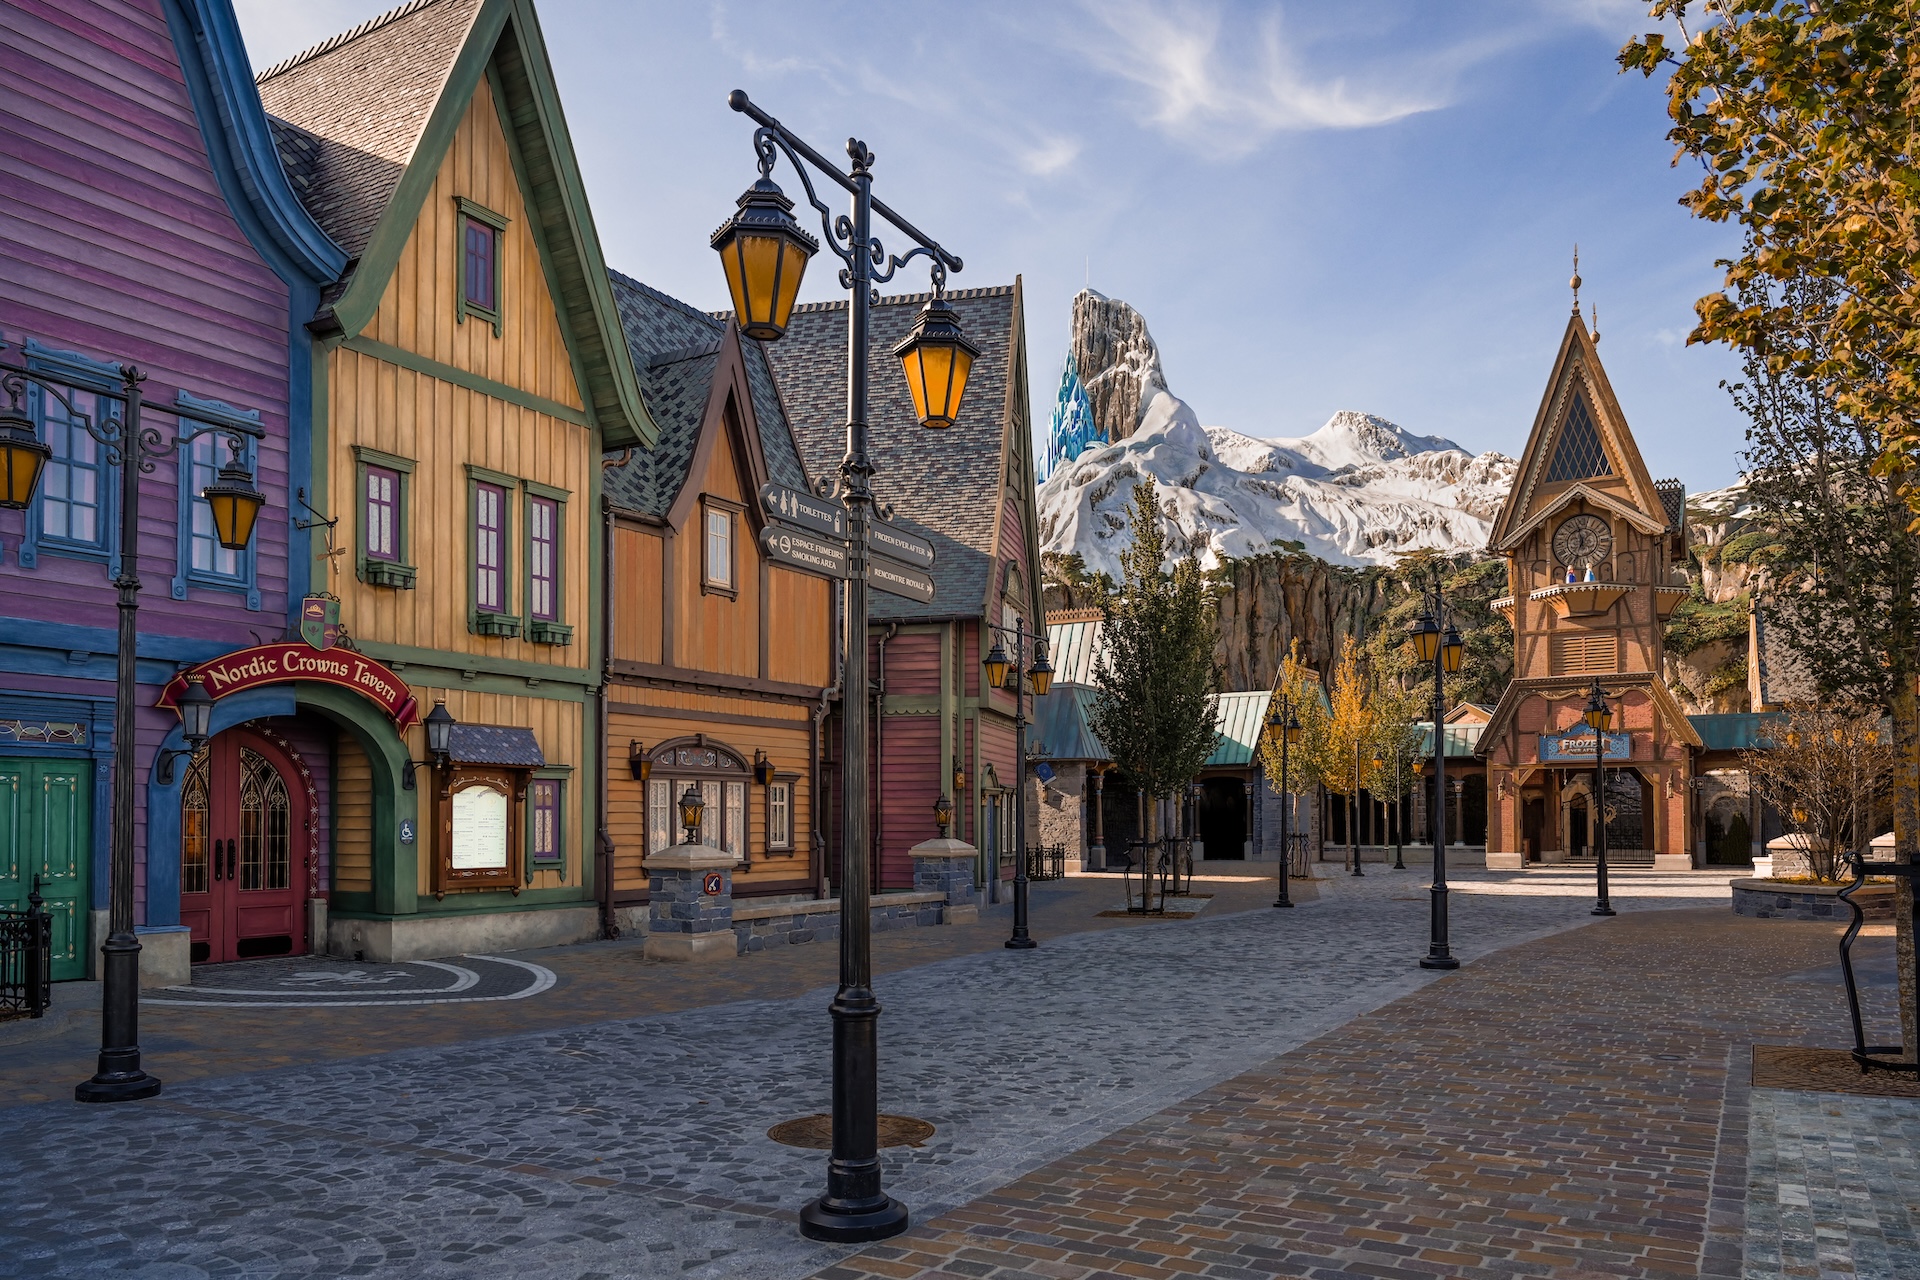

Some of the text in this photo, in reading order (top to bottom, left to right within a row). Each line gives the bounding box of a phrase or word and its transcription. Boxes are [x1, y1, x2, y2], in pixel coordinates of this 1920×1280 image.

[799, 504, 832, 522] TOILETTES
[792, 537, 844, 560] ESPACE FUMEURS
[874, 531, 926, 556] FROZEN EVER AFTER
[791, 550, 837, 570] SMOKING AREA
[874, 568, 925, 590] RENCONTRE ROYALE
[207, 650, 397, 703] Nordic Crowns Tavern
